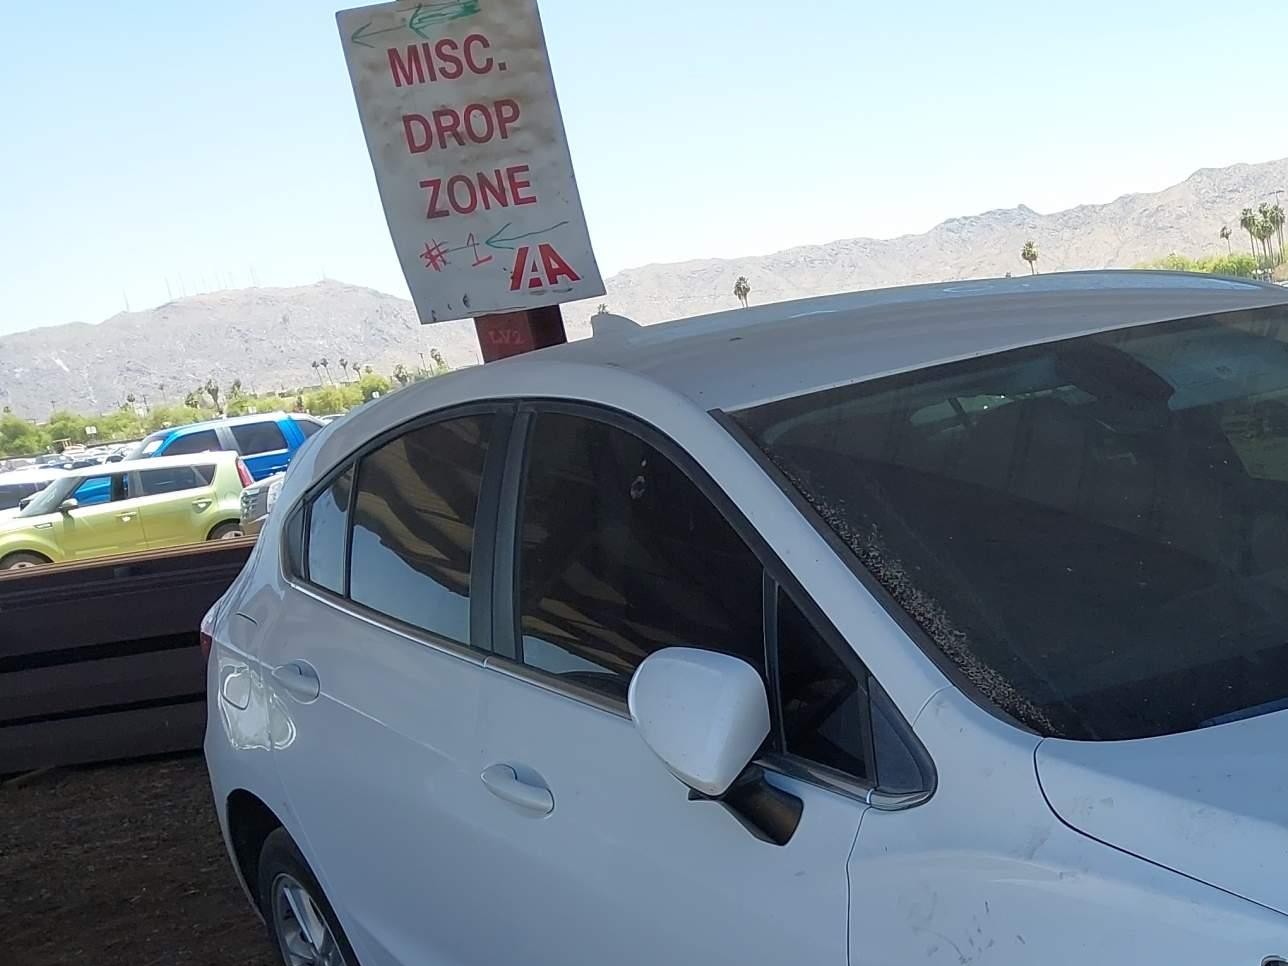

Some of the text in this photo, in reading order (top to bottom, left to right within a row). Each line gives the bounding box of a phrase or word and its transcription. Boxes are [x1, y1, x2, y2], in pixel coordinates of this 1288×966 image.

[386, 34, 507, 88] MISC.
[401, 99, 521, 155] DROP
[418, 164, 538, 219] ZONE
